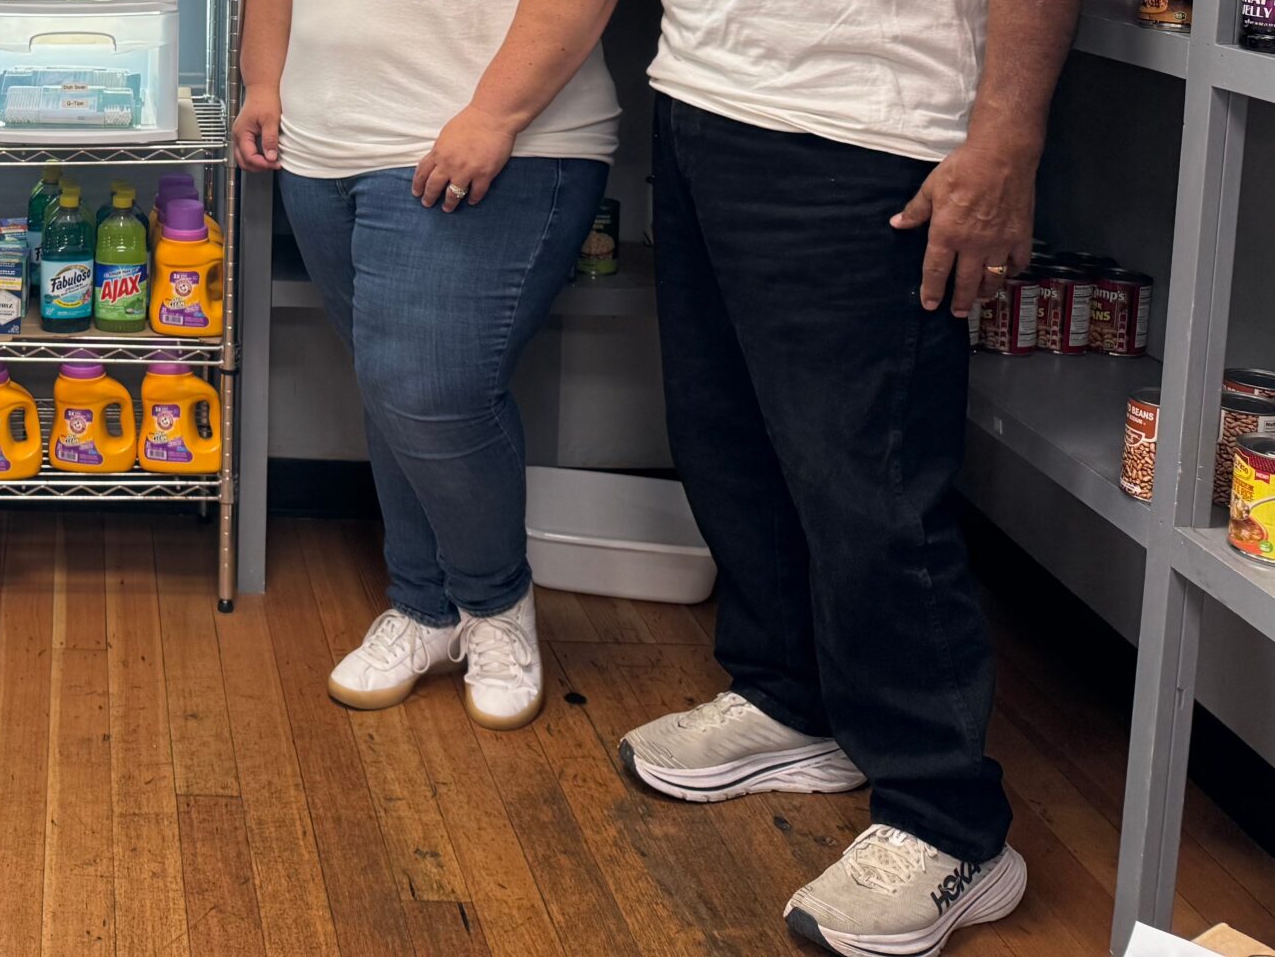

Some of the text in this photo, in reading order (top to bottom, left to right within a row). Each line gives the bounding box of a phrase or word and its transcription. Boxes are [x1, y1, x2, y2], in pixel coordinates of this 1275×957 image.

[51, 268, 91, 292] Fabuloso
[101, 274, 141, 304] AJAX
[1132, 407, 1154, 421] BEANS
[930, 862, 981, 917] HOKA
